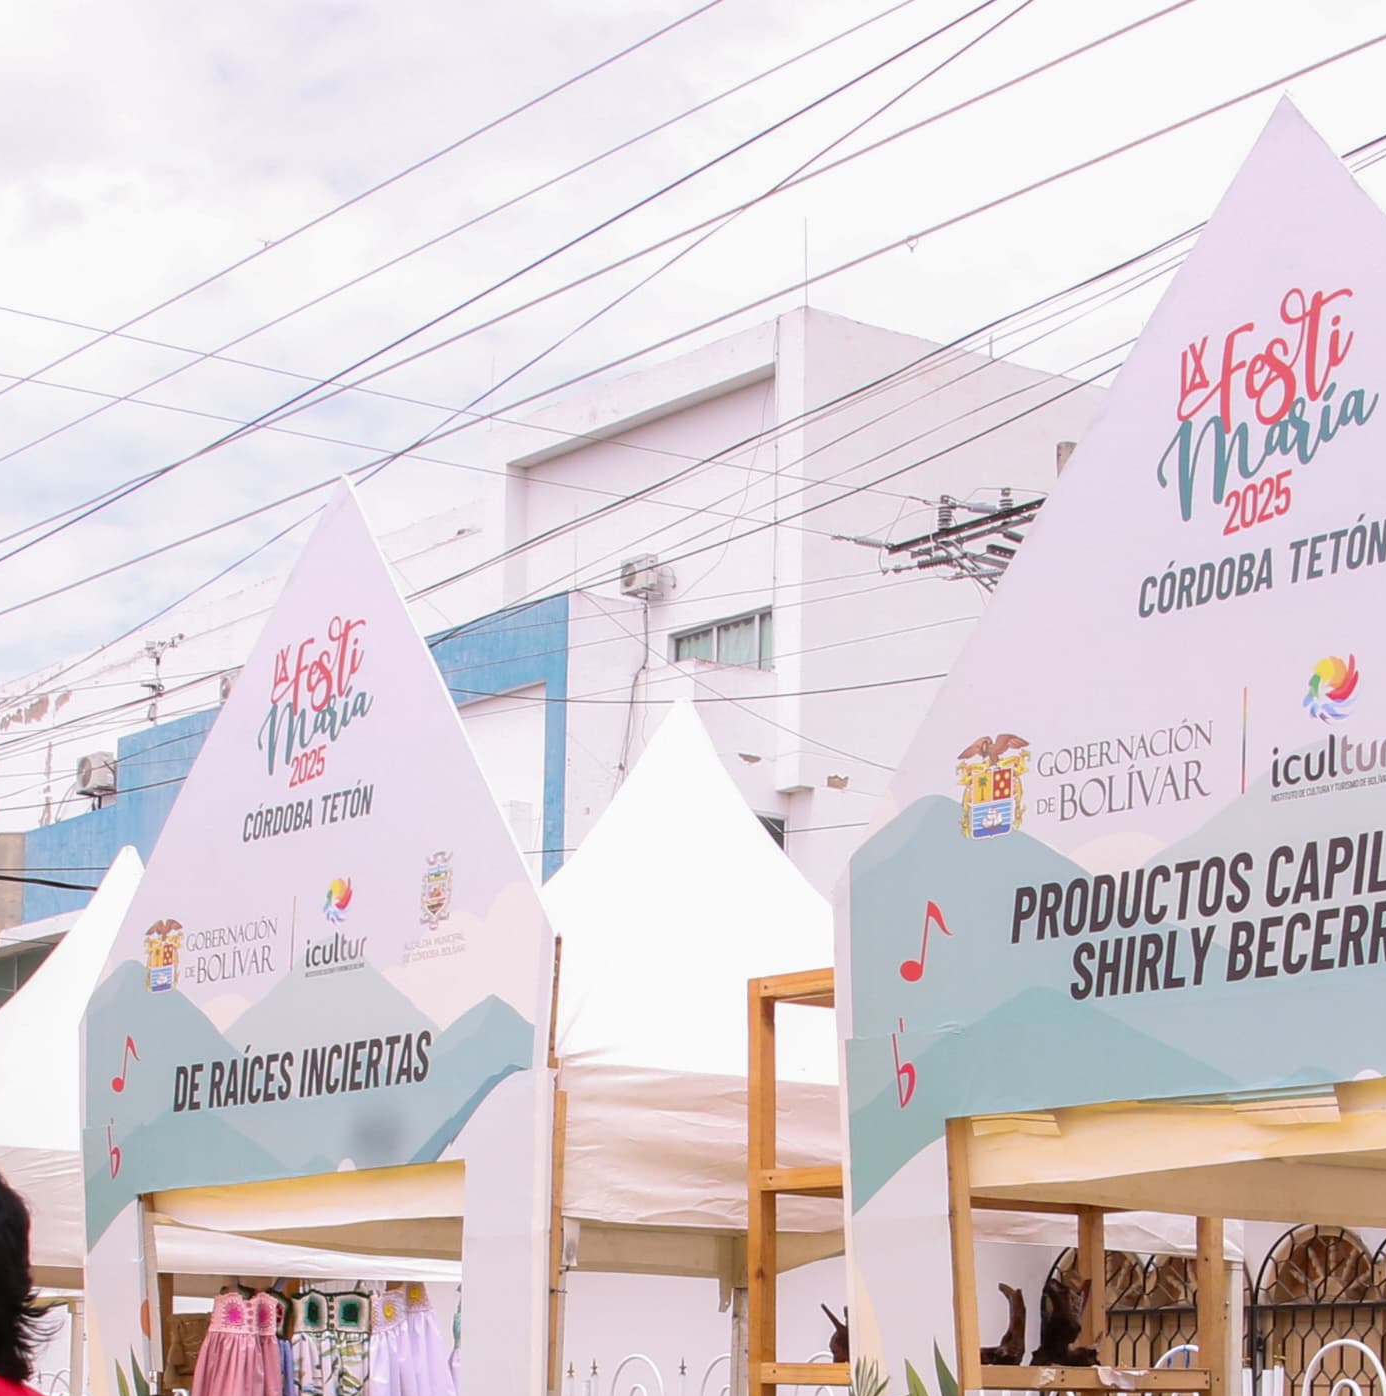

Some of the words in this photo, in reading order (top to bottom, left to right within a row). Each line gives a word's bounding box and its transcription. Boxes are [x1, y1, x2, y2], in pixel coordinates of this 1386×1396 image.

[1177, 288, 1354, 434] Festi
[1180, 335, 1210, 398] IX
[1157, 382, 1379, 522] María
[1223, 469, 1293, 536] 2025
[1138, 547, 1273, 619] CÓRDOBA
[270, 616, 366, 715] Festi
[273, 643, 291, 686] IX
[257, 686, 374, 776] María
[1036, 718, 1213, 778] GOBERNACIÓN
[289, 744, 327, 788] 2025
[1036, 797, 1056, 815] DE
[1059, 759, 1212, 822] BOLÍVAR
[242, 799, 312, 843] CÓRDOBA
[320, 780, 374, 826] TETÓN
[1011, 851, 1253, 945] PRODUCTOS
[186, 915, 278, 952] GOBERNACIÓN
[196, 945, 276, 984] BOLÍVAR
[305, 932, 367, 968] icultur
[1070, 925, 1216, 1001] SHIRLY
[173, 1064, 204, 1113] DE
[208, 1045, 293, 1109] RAÍCES
[300, 1030, 432, 1099] INCIERTAS
